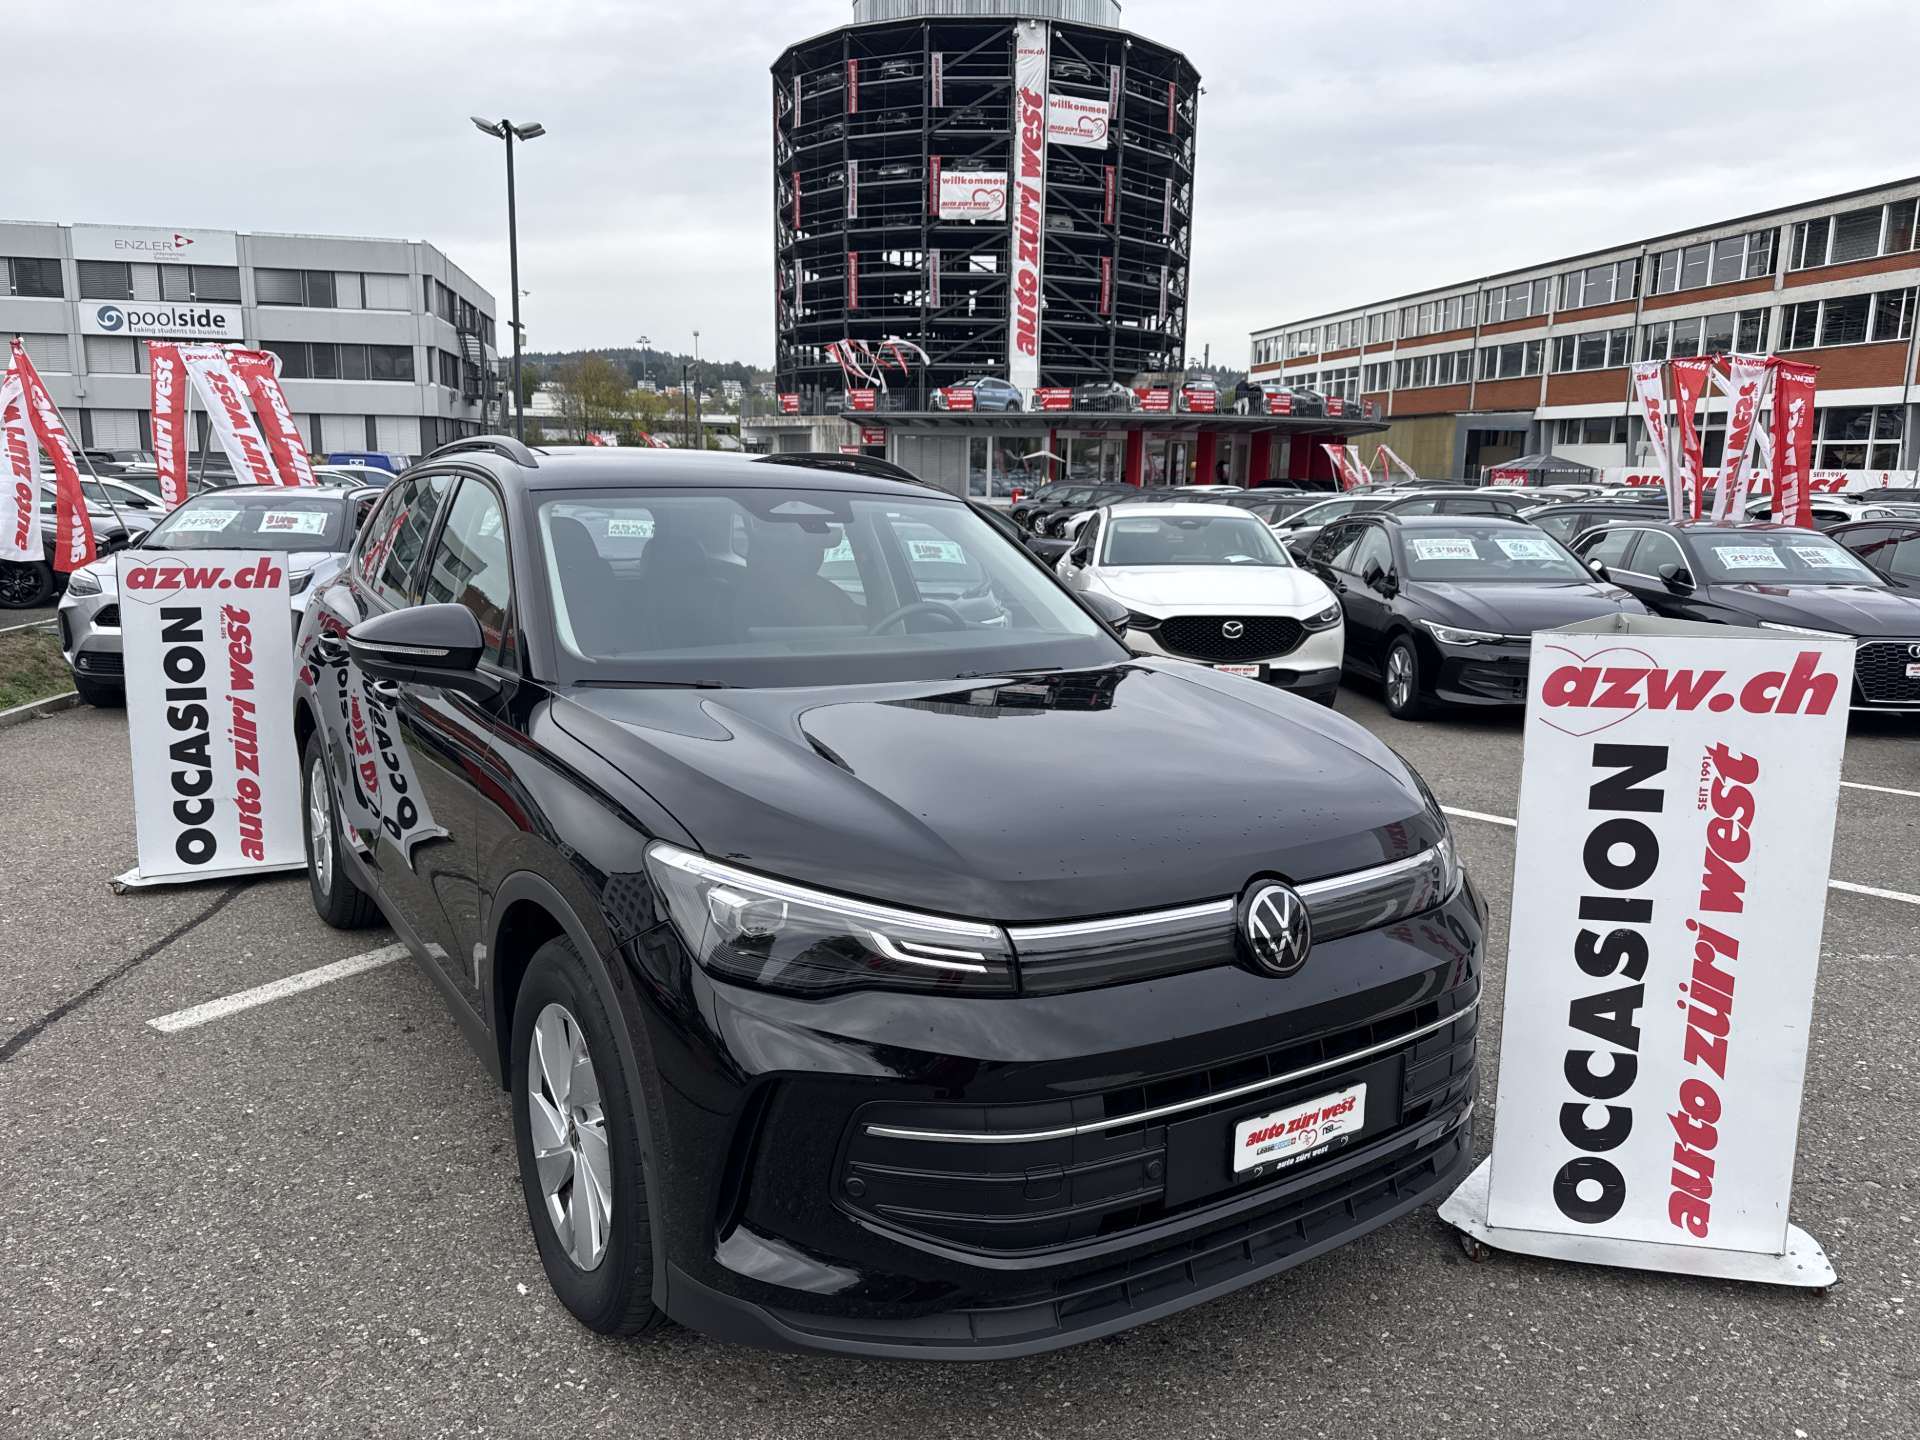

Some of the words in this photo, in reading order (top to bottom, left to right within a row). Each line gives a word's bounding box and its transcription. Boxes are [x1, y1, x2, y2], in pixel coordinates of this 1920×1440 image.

[1017, 87, 1043, 178] west
[1050, 99, 1107, 114] willkommen
[942, 176, 1005, 185] willkommen
[114, 239, 173, 251] ENZLER
[1014, 181, 1041, 267] züri
[127, 308, 226, 332] poolside
[1015, 267, 1039, 357] auto
[154, 356, 174, 414] west
[207, 369, 251, 430] west
[256, 376, 295, 435] west
[3, 427, 32, 482] züri
[154, 416, 175, 474] züri
[14, 483, 33, 551] auto
[126, 557, 282, 590] azw.ch
[222, 603, 254, 691] west
[1542, 651, 1839, 716] azw.ch
[160, 606, 217, 865] OCCASION
[225, 694, 260, 777] züri
[1700, 753, 1712, 780] 1991
[231, 777, 265, 862] auto
[1697, 782, 1709, 811] SEIT
[1698, 741, 1760, 915] west
[1553, 742, 1670, 1225] OCCASION
[1676, 917, 1740, 1082] züri
[1246, 1120, 1285, 1147] auto
[1286, 1108, 1321, 1135] züri
[1321, 1096, 1357, 1121] west
[1665, 1077, 1722, 1240] auto
